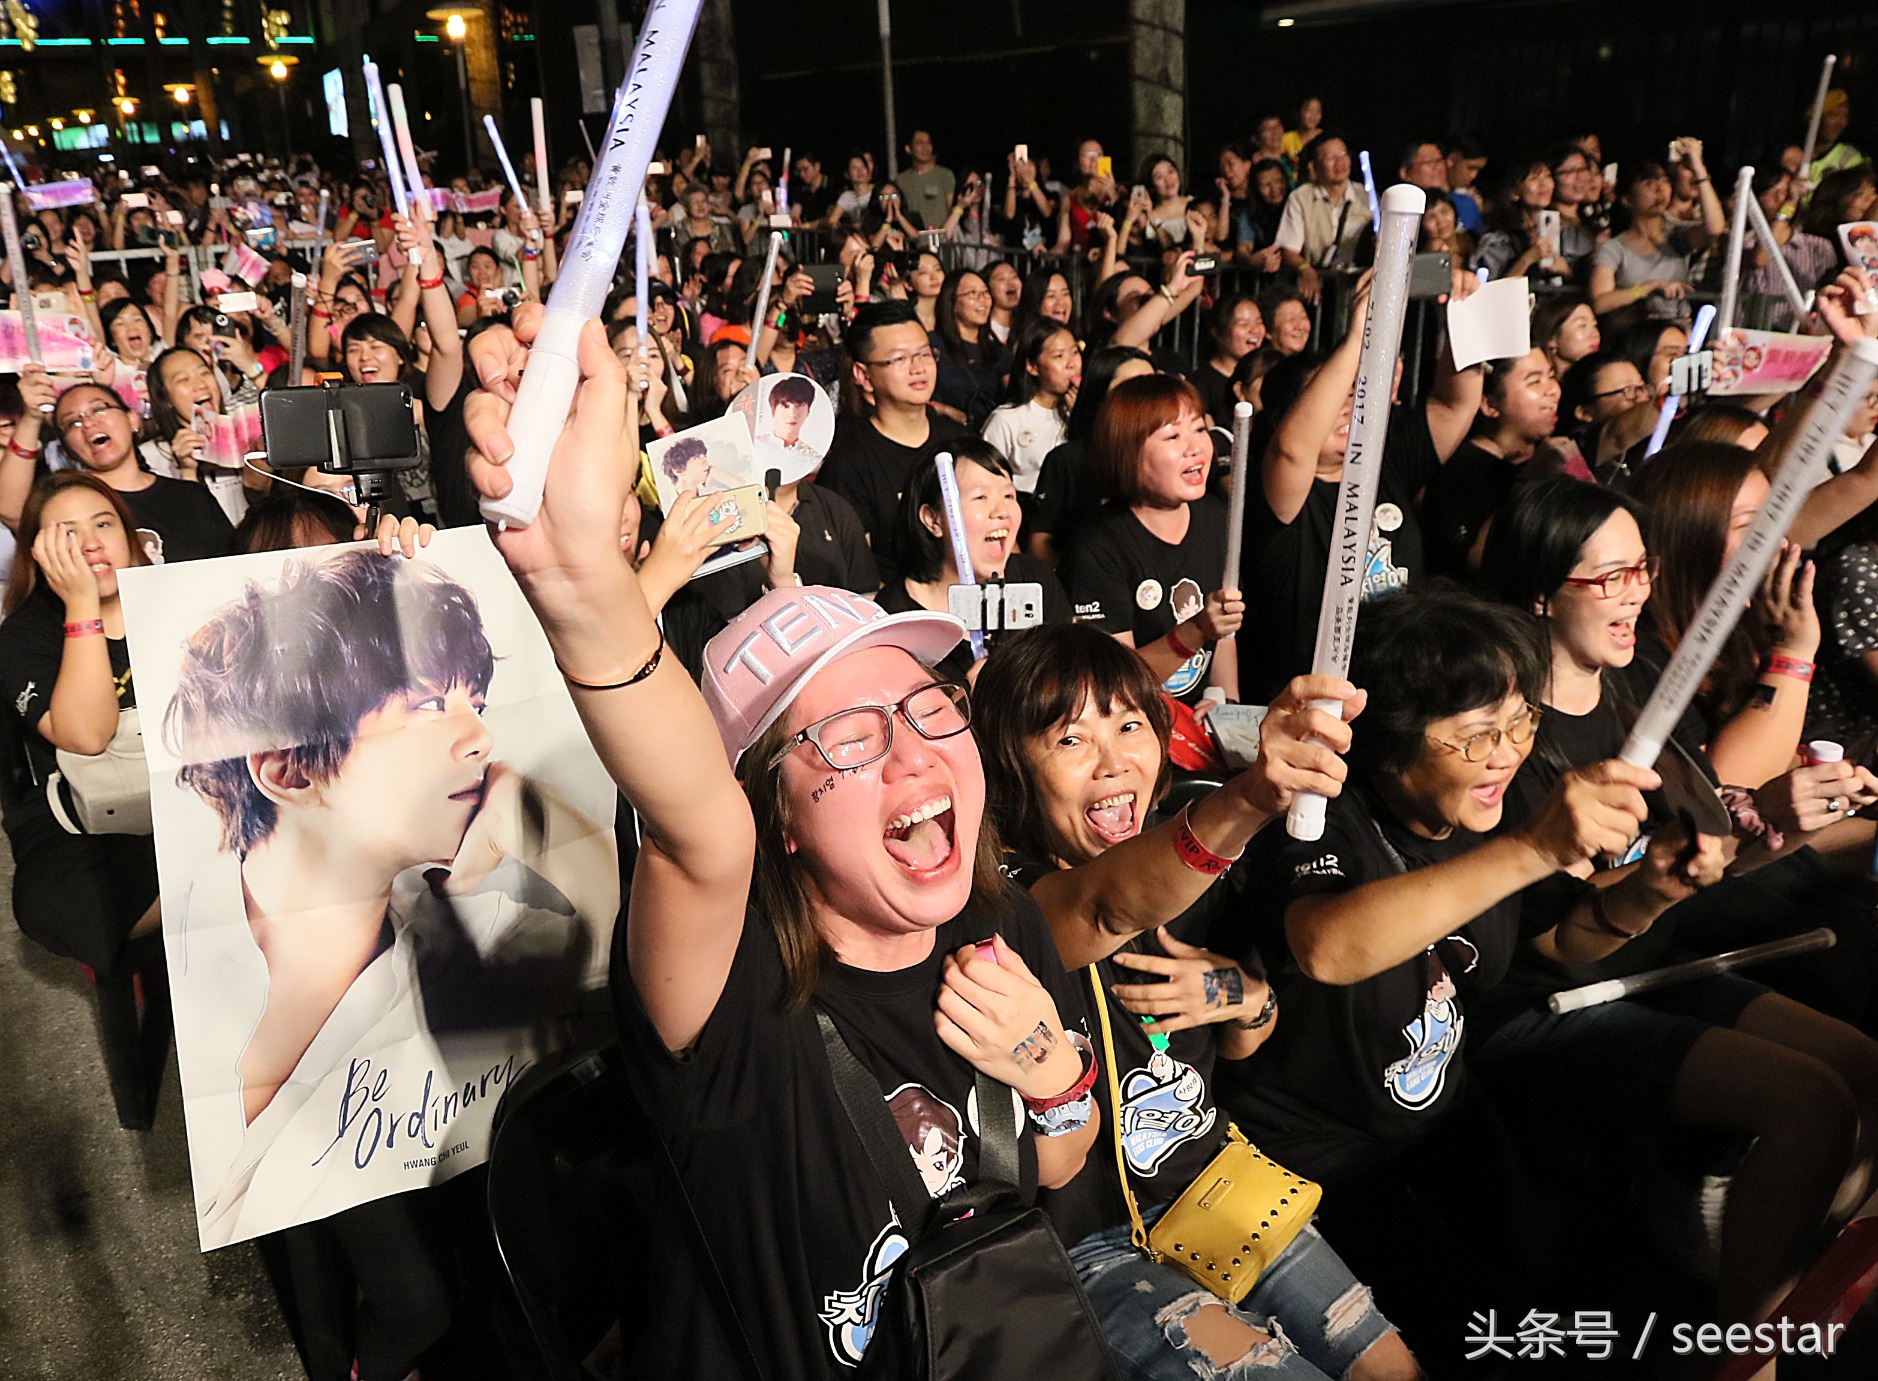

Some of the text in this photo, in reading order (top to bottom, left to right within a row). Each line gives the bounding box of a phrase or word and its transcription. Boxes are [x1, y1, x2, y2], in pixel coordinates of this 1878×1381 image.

[609, 29, 659, 151] MALAYSIA
[1353, 375, 1368, 425] 2017
[1349, 441, 1363, 465] IN
[1340, 481, 1361, 586] MALAYSIA
[1074, 601, 1100, 614] ten2
[811, 776, 835, 803] 황치열
[312, 1057, 392, 1167] Be
[403, 1140, 470, 1171] HWANG CHI YEUL
